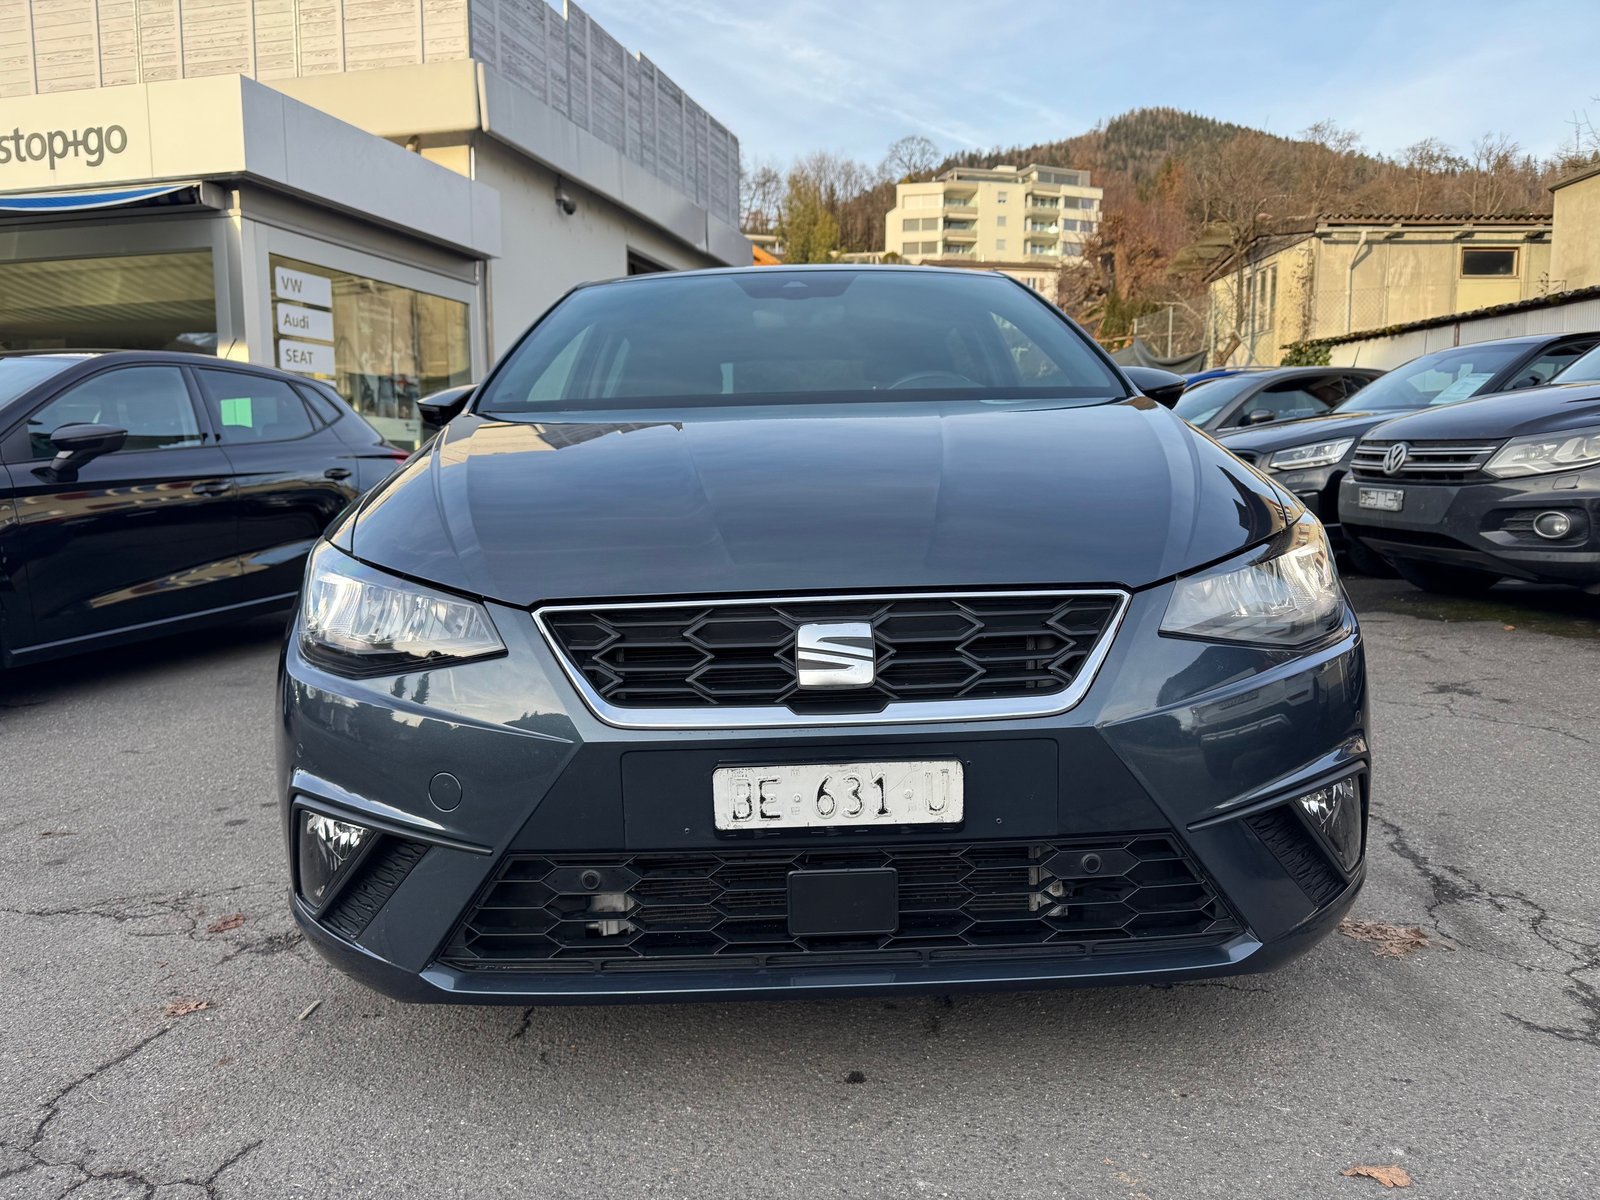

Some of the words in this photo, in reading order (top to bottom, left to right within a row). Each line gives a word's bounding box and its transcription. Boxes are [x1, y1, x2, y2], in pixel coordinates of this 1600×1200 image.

[0, 124, 127, 170] stop+go
[281, 275, 302, 293] VW
[283, 313, 309, 329] Audi
[285, 348, 313, 364] SEAT
[815, 773, 892, 819] 631
